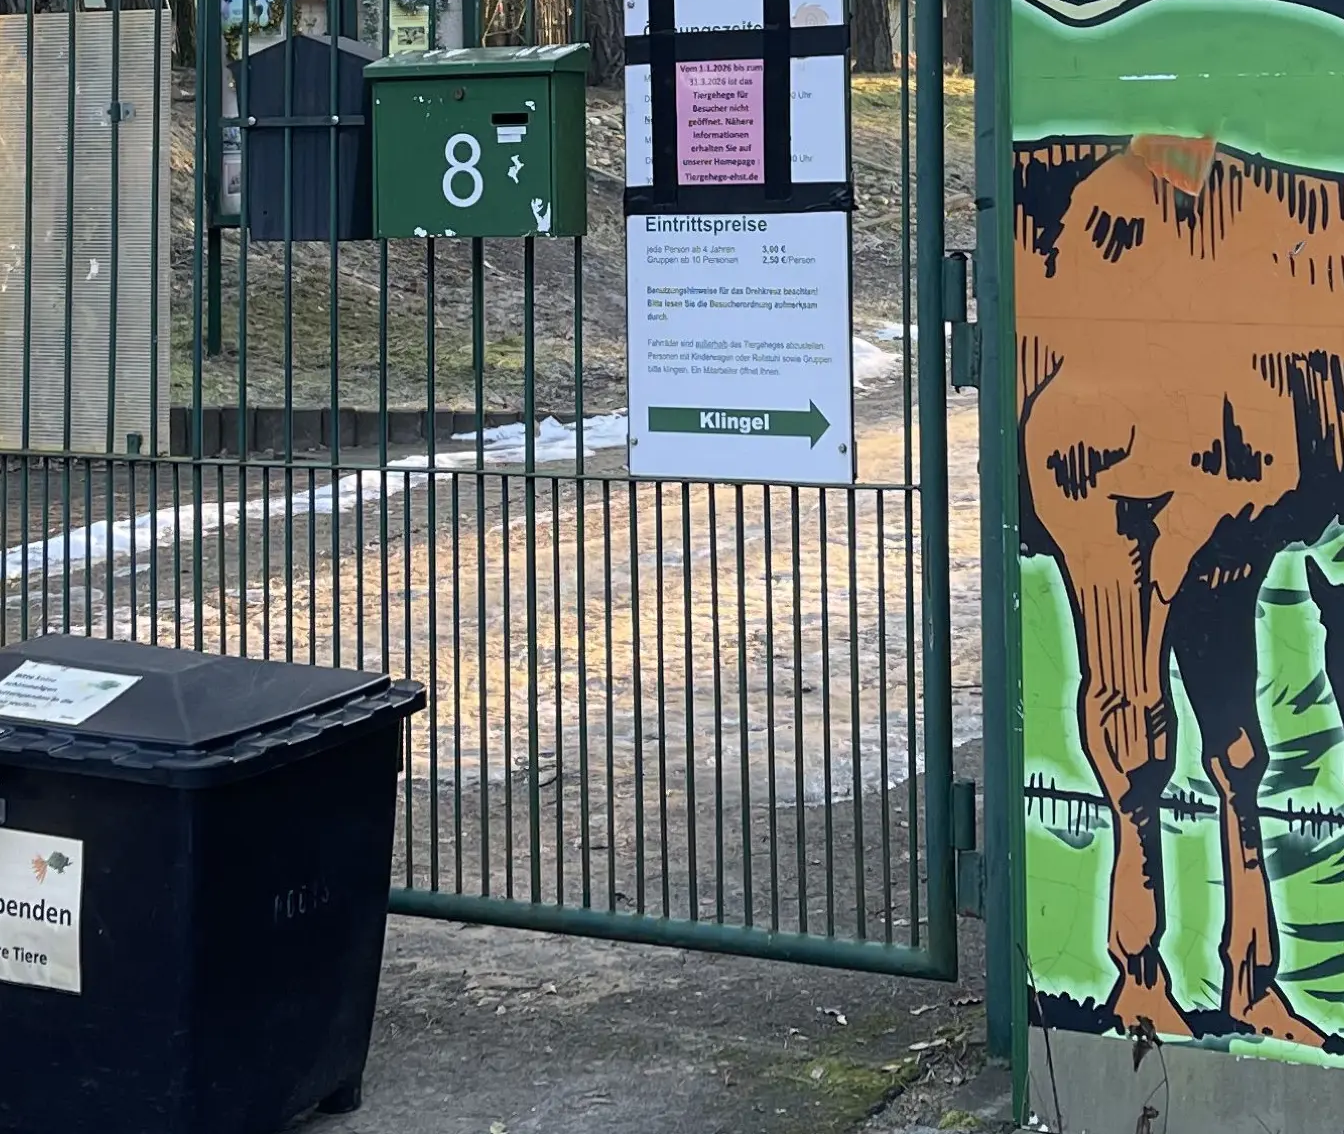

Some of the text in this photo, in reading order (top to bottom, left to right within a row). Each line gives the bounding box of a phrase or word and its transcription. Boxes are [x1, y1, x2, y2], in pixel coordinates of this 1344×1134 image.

[679, 65, 698, 73] Vom
[699, 64, 732, 73] 1.1.2026
[733, 64, 745, 72] bis
[689, 77, 753, 86] 31.3.2026 ist das
[693, 90, 749, 100] Tiergehege für
[798, 90, 812, 99] Uhr
[692, 104, 749, 113] Besucher nicht
[688, 117, 754, 128] geöffnet. Nähere
[692, 130, 750, 139] Informationen
[691, 144, 752, 153] erhalten Sie auf
[682, 158, 713, 166] unserer
[713, 157, 756, 167] Homepage
[442, 132, 484, 208] 8
[685, 172, 759, 183] Tiergehege-ehst.de
[645, 216, 768, 235] Eintrittspreise
[646, 246, 662, 255] jede
[664, 246, 690, 254] Person
[692, 246, 702, 254] ab
[710, 246, 736, 254] Jahren
[780, 245, 786, 254] €
[646, 256, 679, 266] Gruppen
[680, 256, 690, 264] ab
[692, 256, 701, 264] 10
[702, 256, 739, 264] Personen
[646, 286, 718, 296] Benutzungshinweise
[719, 286, 730, 295] für
[731, 286, 744, 295] das
[745, 286, 781, 296] Drehkreuz
[646, 299, 818, 310] Bitte lesen Sie die Besucherordnung aufmerksam
[647, 339, 679, 348] Fahrräder
[680, 339, 694, 348] sind
[695, 339, 728, 349] außerhalb
[729, 340, 742, 349] des
[743, 340, 785, 351] Tiergeheges
[647, 352, 832, 365] Personen mit Kinderwagen oder Rollstuhl sowie Gruppen
[647, 366, 662, 374] bitte
[691, 366, 702, 375] Ein
[703, 366, 738, 376] Mitarbeiter
[699, 411, 770, 434] Klingel
[12, 946, 48, 965] Tiere
